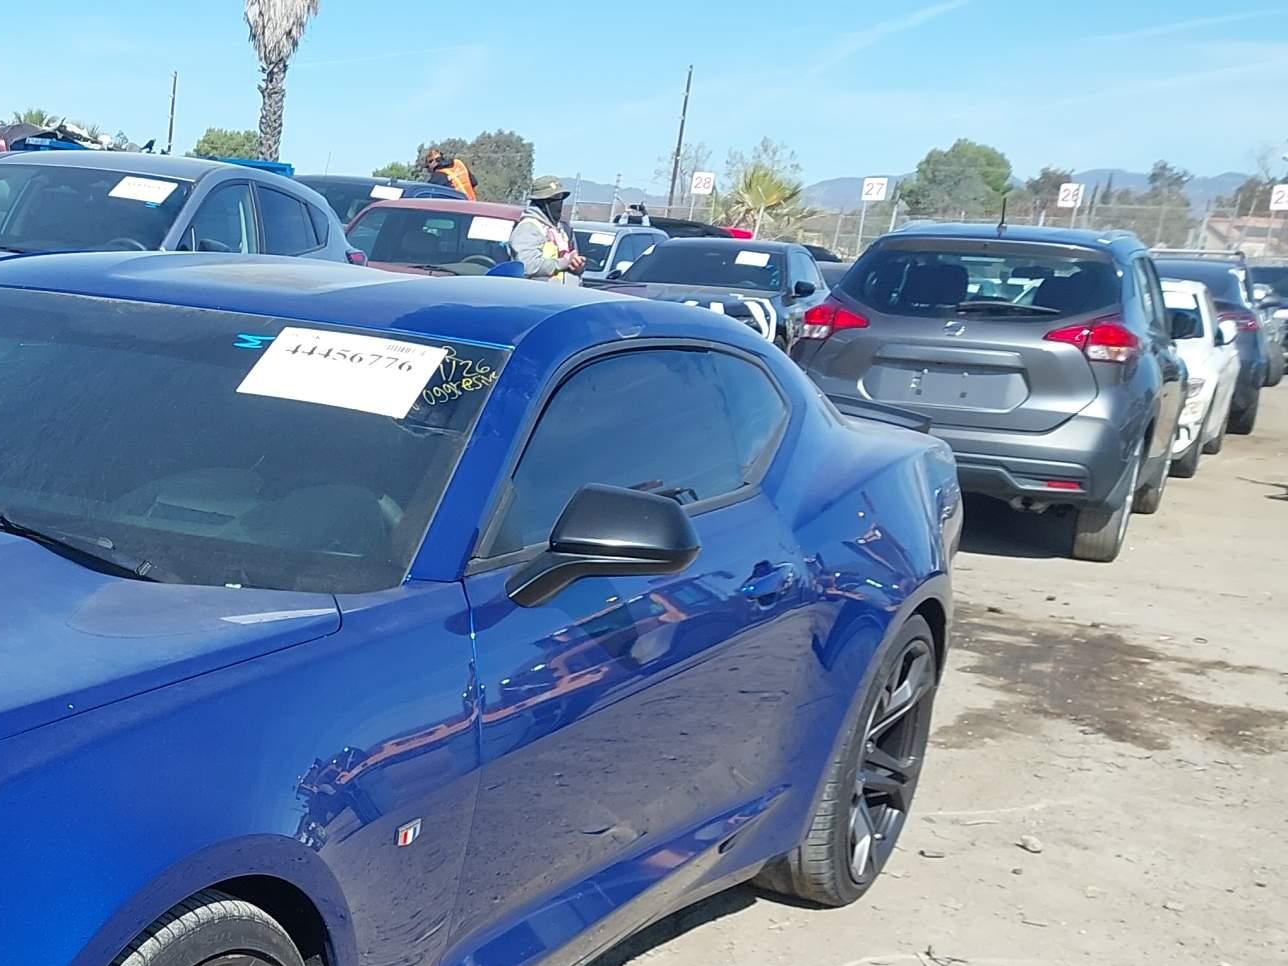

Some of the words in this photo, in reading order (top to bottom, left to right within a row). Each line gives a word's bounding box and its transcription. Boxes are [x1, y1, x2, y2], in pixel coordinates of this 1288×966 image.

[693, 175, 712, 190] 28
[864, 181, 885, 197] 27
[1273, 189, 1288, 205] 2
[285, 343, 413, 373] 44456776
